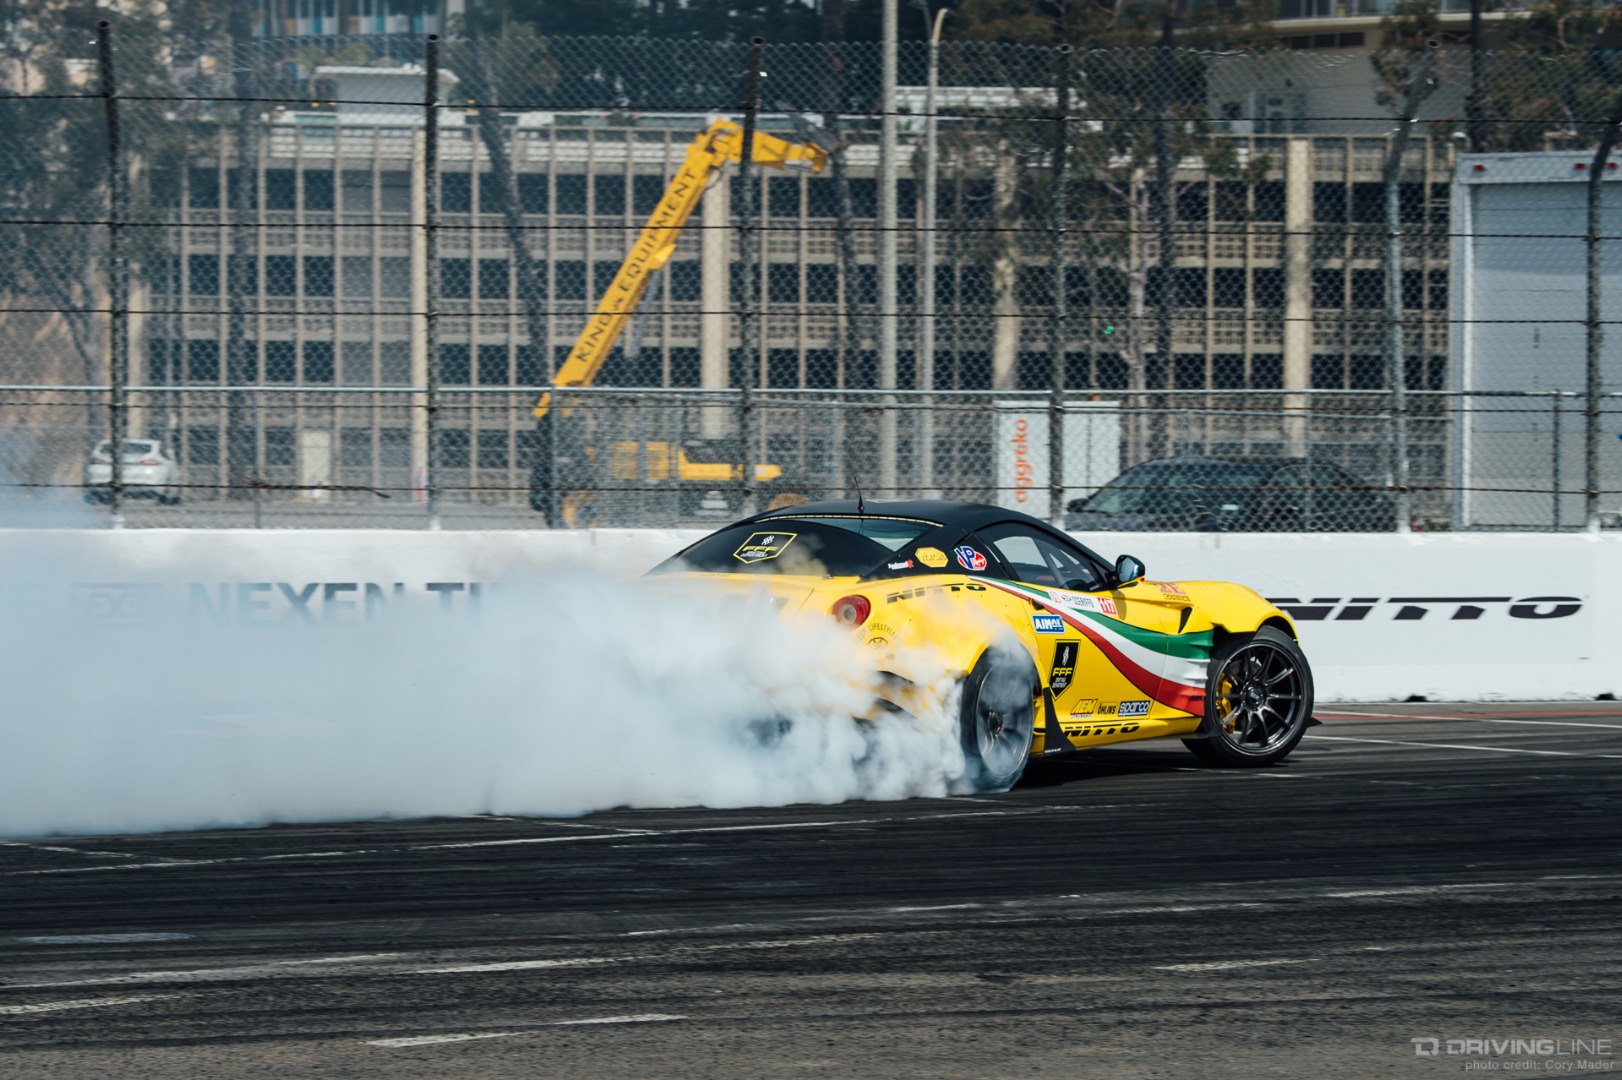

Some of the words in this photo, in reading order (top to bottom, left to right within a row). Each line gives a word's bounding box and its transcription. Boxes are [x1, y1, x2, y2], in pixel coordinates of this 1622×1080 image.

[618, 168, 697, 292] EQUIPMENT
[1010, 419, 1033, 504] aggreko
[1264, 596, 1583, 620] NITTO
[1052, 667, 1073, 677] FFF
[1119, 701, 1150, 714] sparco
[1064, 722, 1141, 737] NITTO
